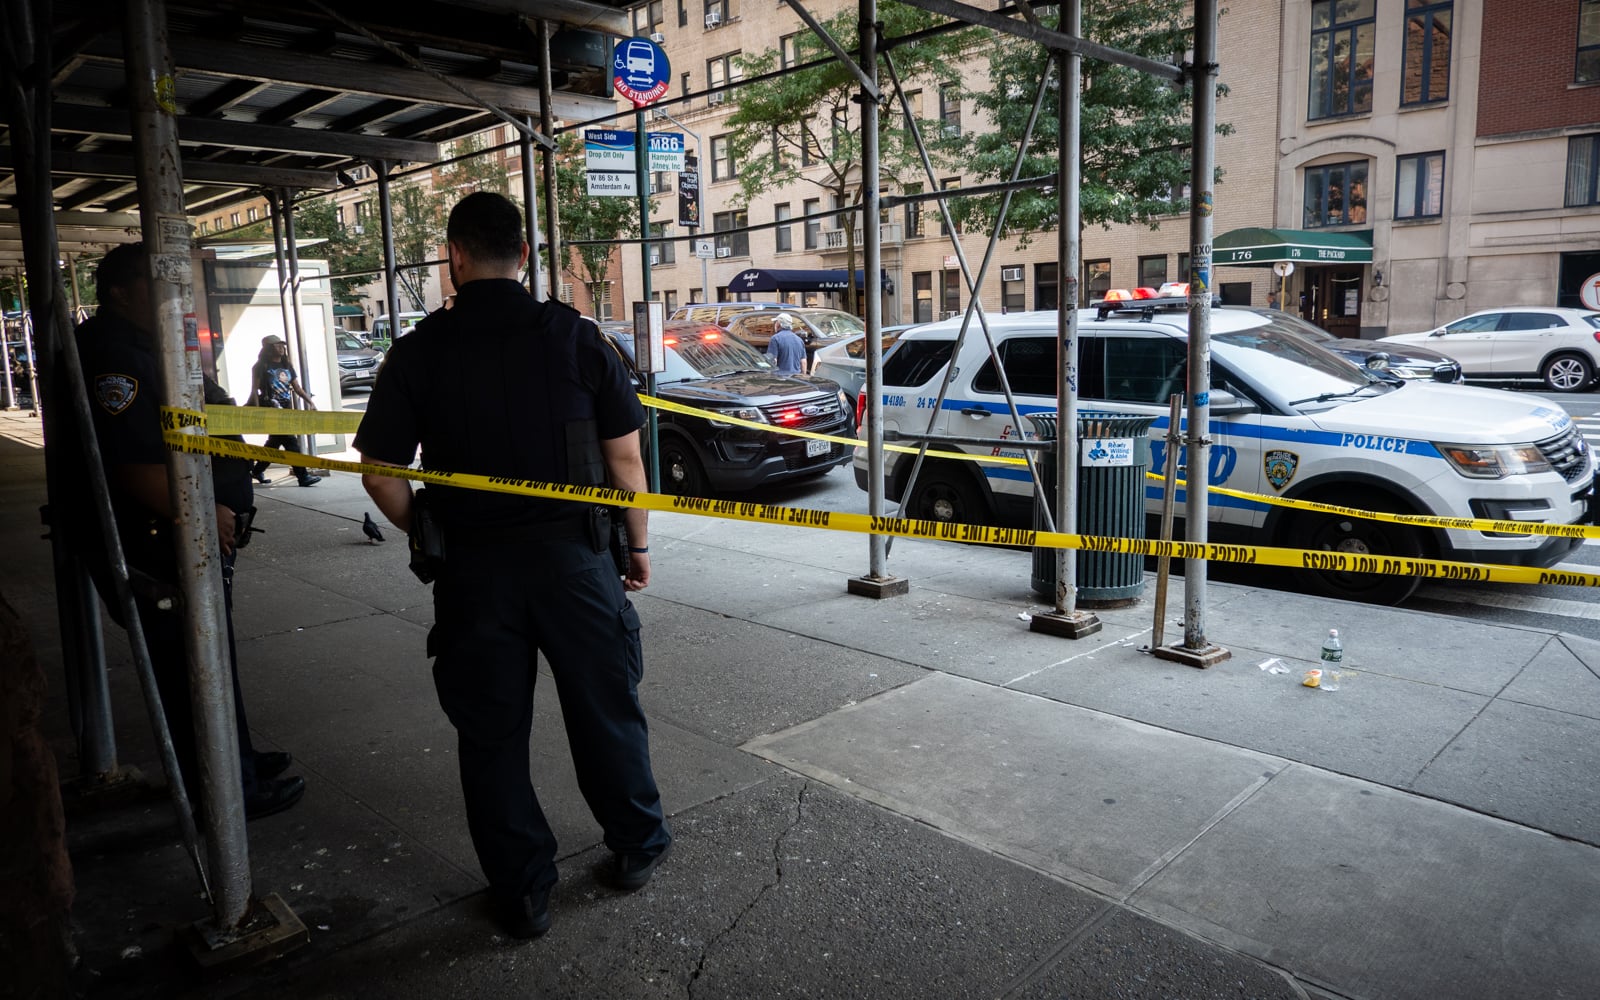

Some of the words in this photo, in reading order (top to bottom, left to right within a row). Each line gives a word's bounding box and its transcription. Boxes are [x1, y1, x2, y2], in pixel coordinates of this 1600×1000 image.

[616, 80, 628, 92] NO
[628, 84, 664, 100] STANDING
[588, 132, 602, 140] West
[651, 136, 678, 151] M86
[588, 151, 602, 159] Drop
[613, 152, 624, 160] Only
[652, 153, 677, 161] Hampton
[1232, 251, 1252, 260] 176
[1292, 249, 1301, 257] 176
[1318, 250, 1326, 258] THE
[917, 397, 925, 408] 24
[928, 398, 937, 408] PC
[1343, 433, 1406, 453] POLICE
[713, 500, 736, 514] NOT
[740, 502, 755, 516] DO
[759, 504, 785, 520] LINE
[789, 508, 830, 526] POLICE
[870, 516, 910, 533] CROSS
[913, 520, 937, 536] NOT
[942, 522, 958, 538] DO
[962, 525, 988, 542] LINE
[993, 528, 1037, 545] POLICE
[1178, 542, 1206, 559] LINE
[1211, 545, 1256, 563] POLICE
[1302, 552, 1346, 570] CROSS
